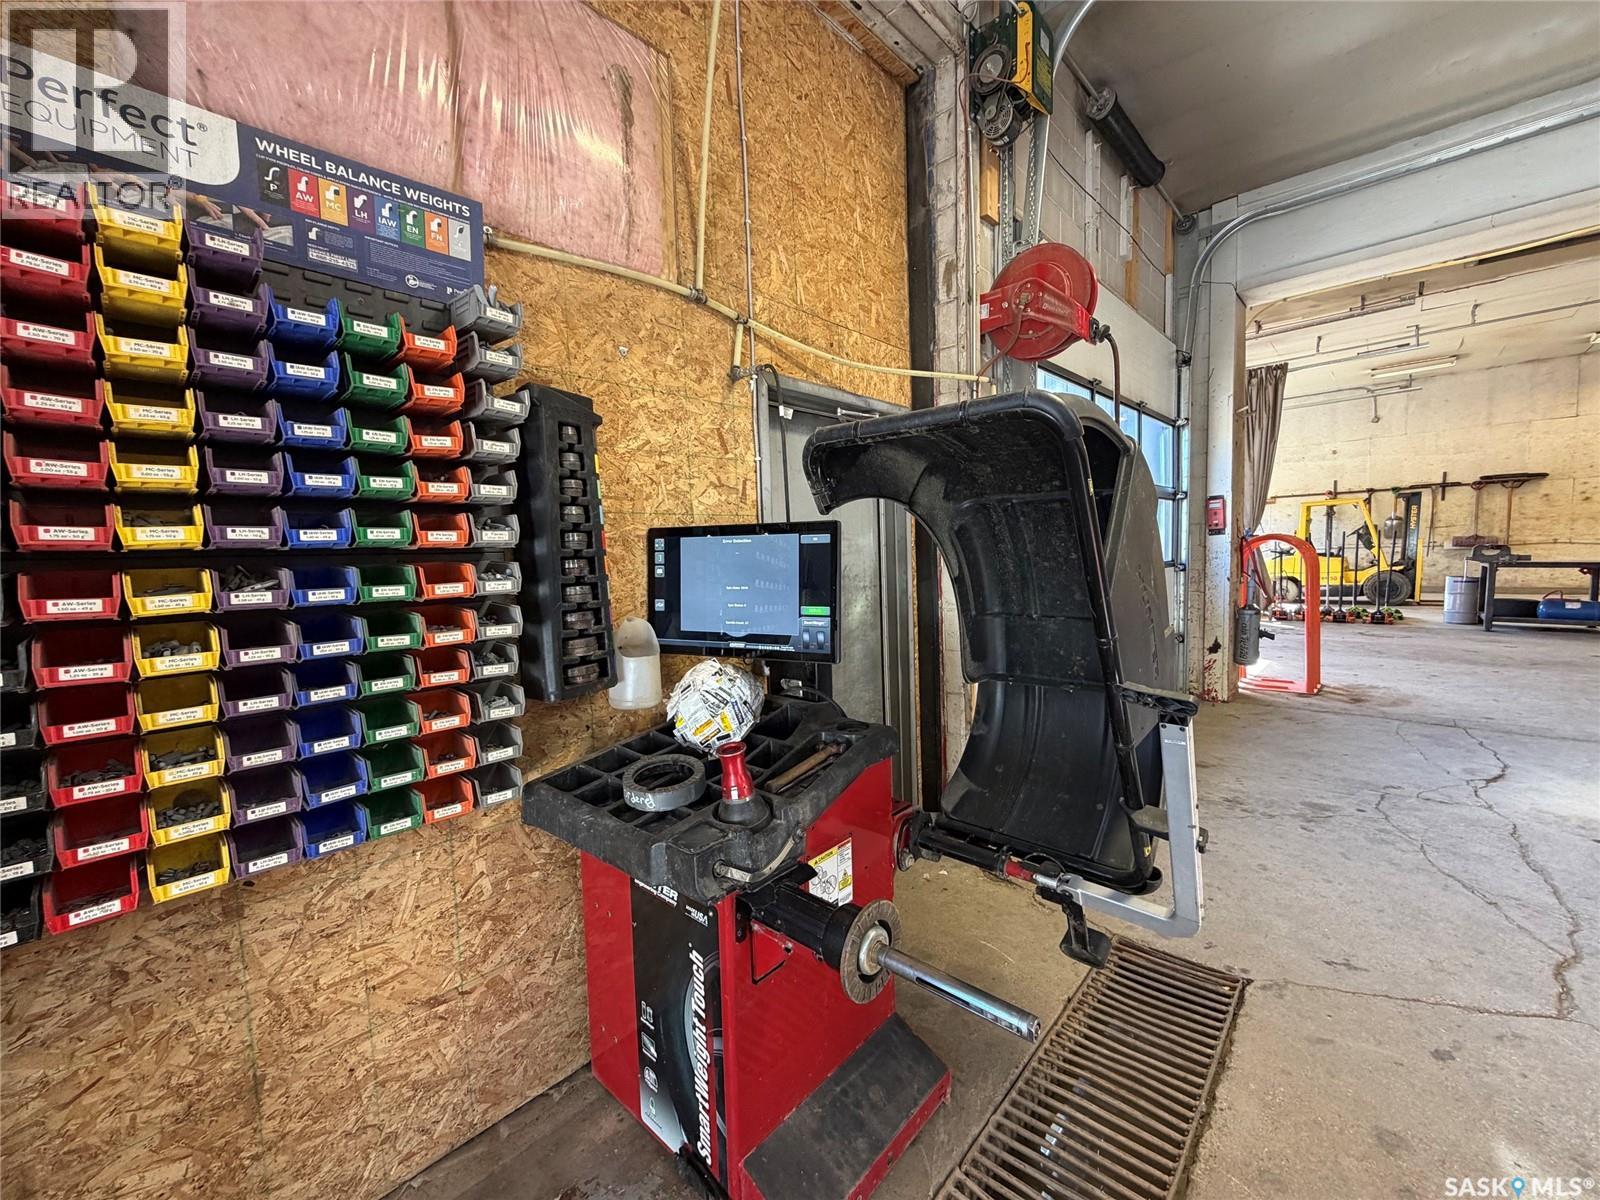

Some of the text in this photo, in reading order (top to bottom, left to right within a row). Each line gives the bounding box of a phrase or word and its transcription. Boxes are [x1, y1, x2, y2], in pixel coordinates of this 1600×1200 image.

[1, 90, 199, 168] EQUIPMENT
[255, 136, 322, 170] WHEEL
[325, 160, 400, 195] BALANCE
[404, 186, 470, 217] WEIGHTS
[270, 183, 278, 191] P
[296, 192, 314, 203] AW
[326, 201, 342, 211] MC
[355, 209, 368, 219] LH
[379, 217, 397, 228] IAW
[406, 225, 419, 235] EN
[431, 233, 443, 241] FN
